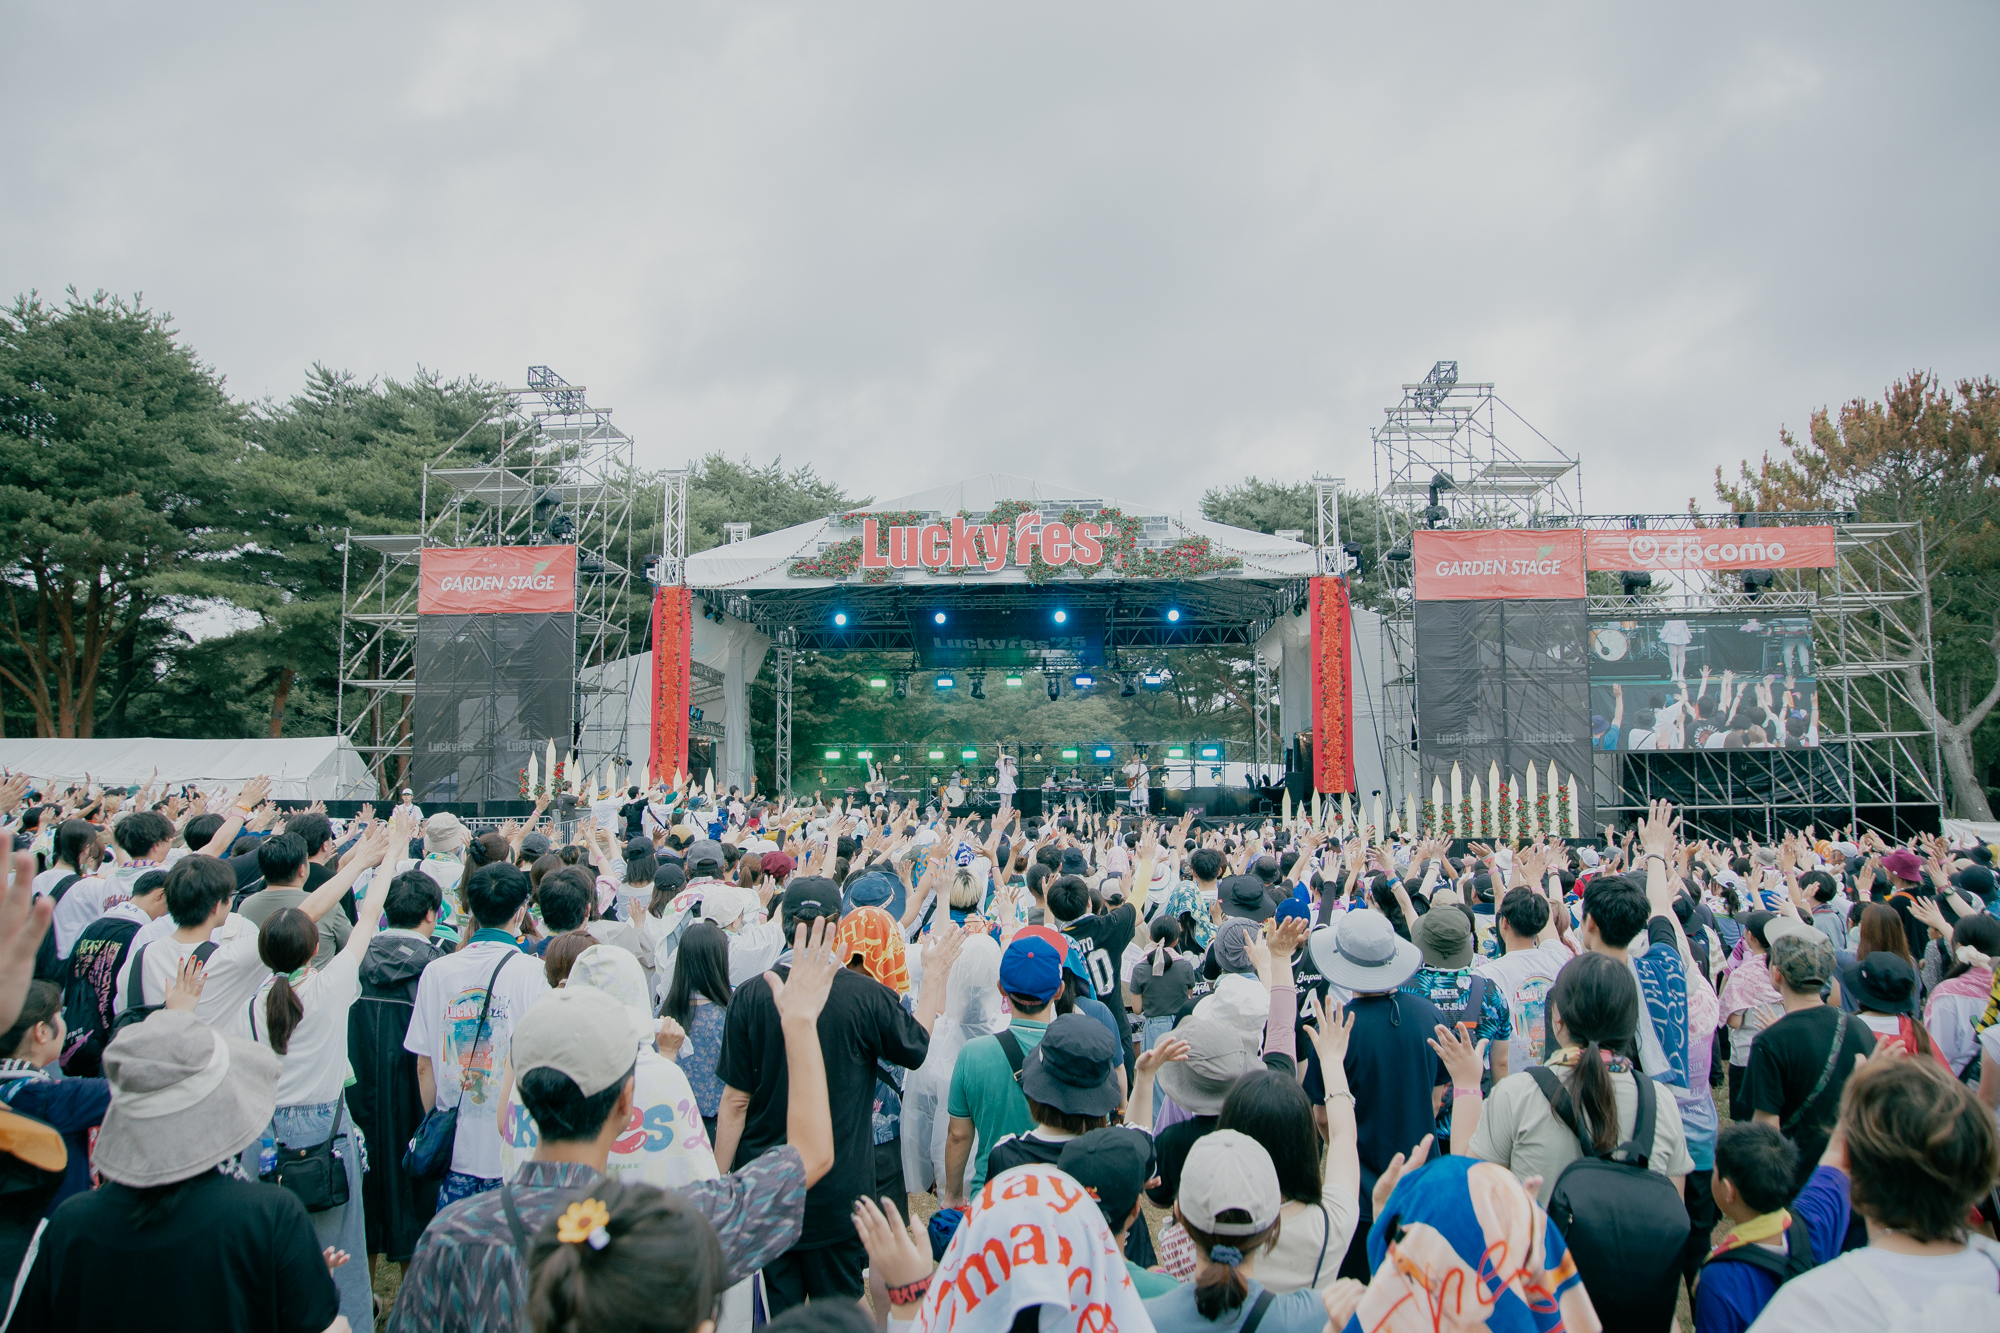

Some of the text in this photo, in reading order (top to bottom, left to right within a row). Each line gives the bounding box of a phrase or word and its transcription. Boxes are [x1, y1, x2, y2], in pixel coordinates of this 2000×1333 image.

[1685, 536, 1702, 544] NTT
[1665, 537, 1786, 563] docomo
[1435, 559, 1562, 577] GARDEN STAGE
[440, 575, 556, 591] GARDEN STAGE
[1430, 988, 1459, 997] ROCK
